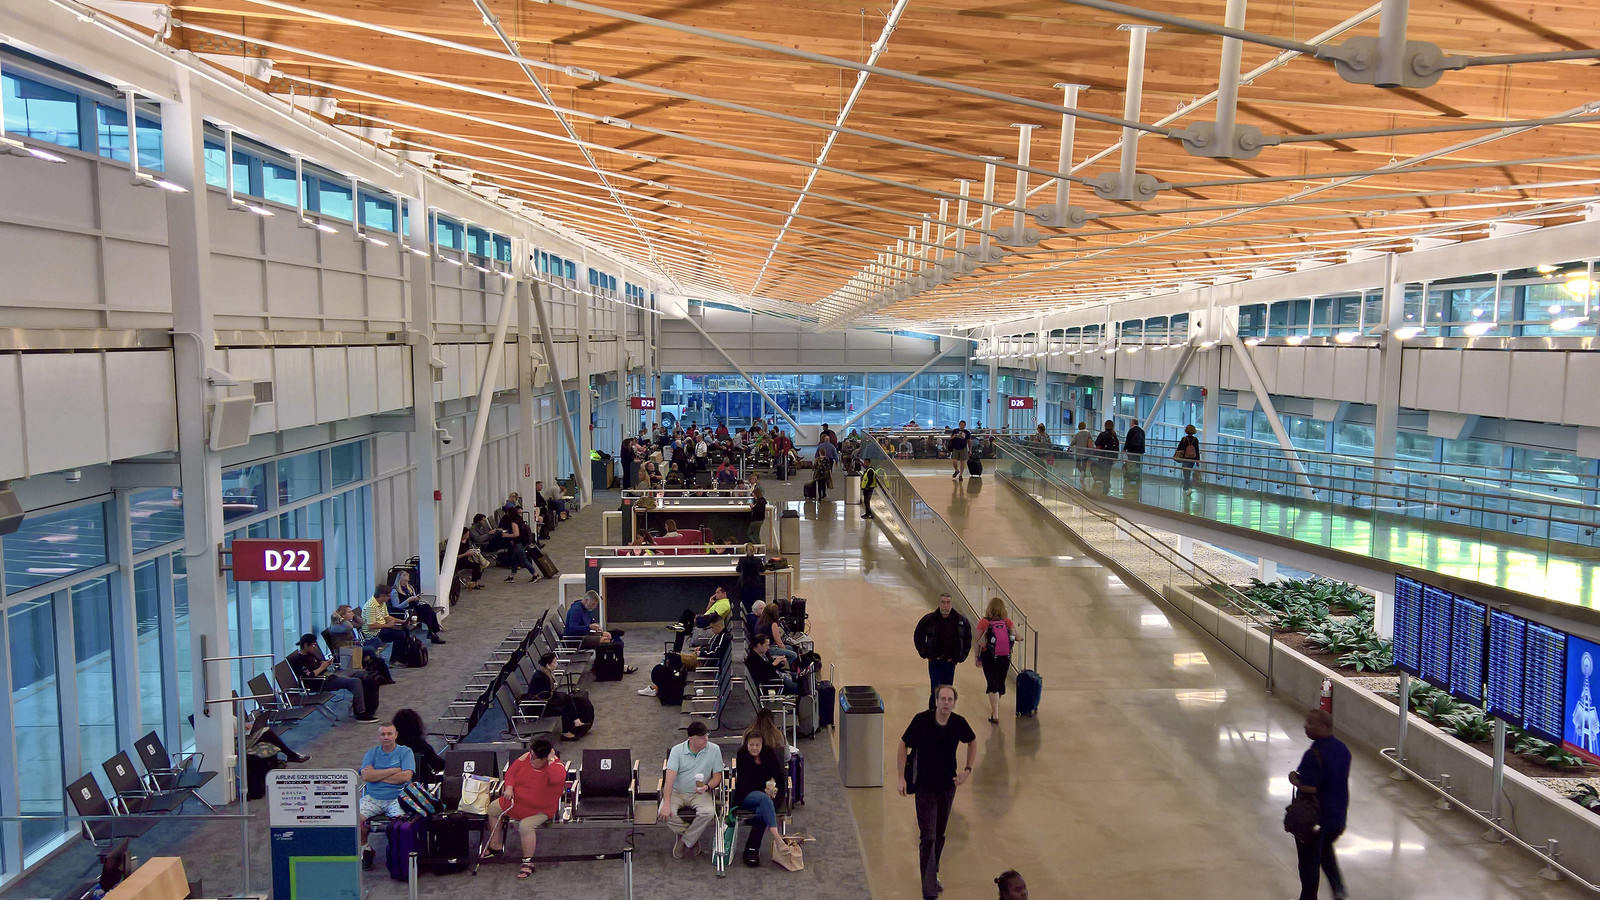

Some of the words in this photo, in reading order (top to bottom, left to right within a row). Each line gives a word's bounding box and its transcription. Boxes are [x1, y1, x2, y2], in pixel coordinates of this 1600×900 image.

[641, 399, 654, 407] D21
[1011, 399, 1025, 407] D26
[264, 549, 311, 571] D22
